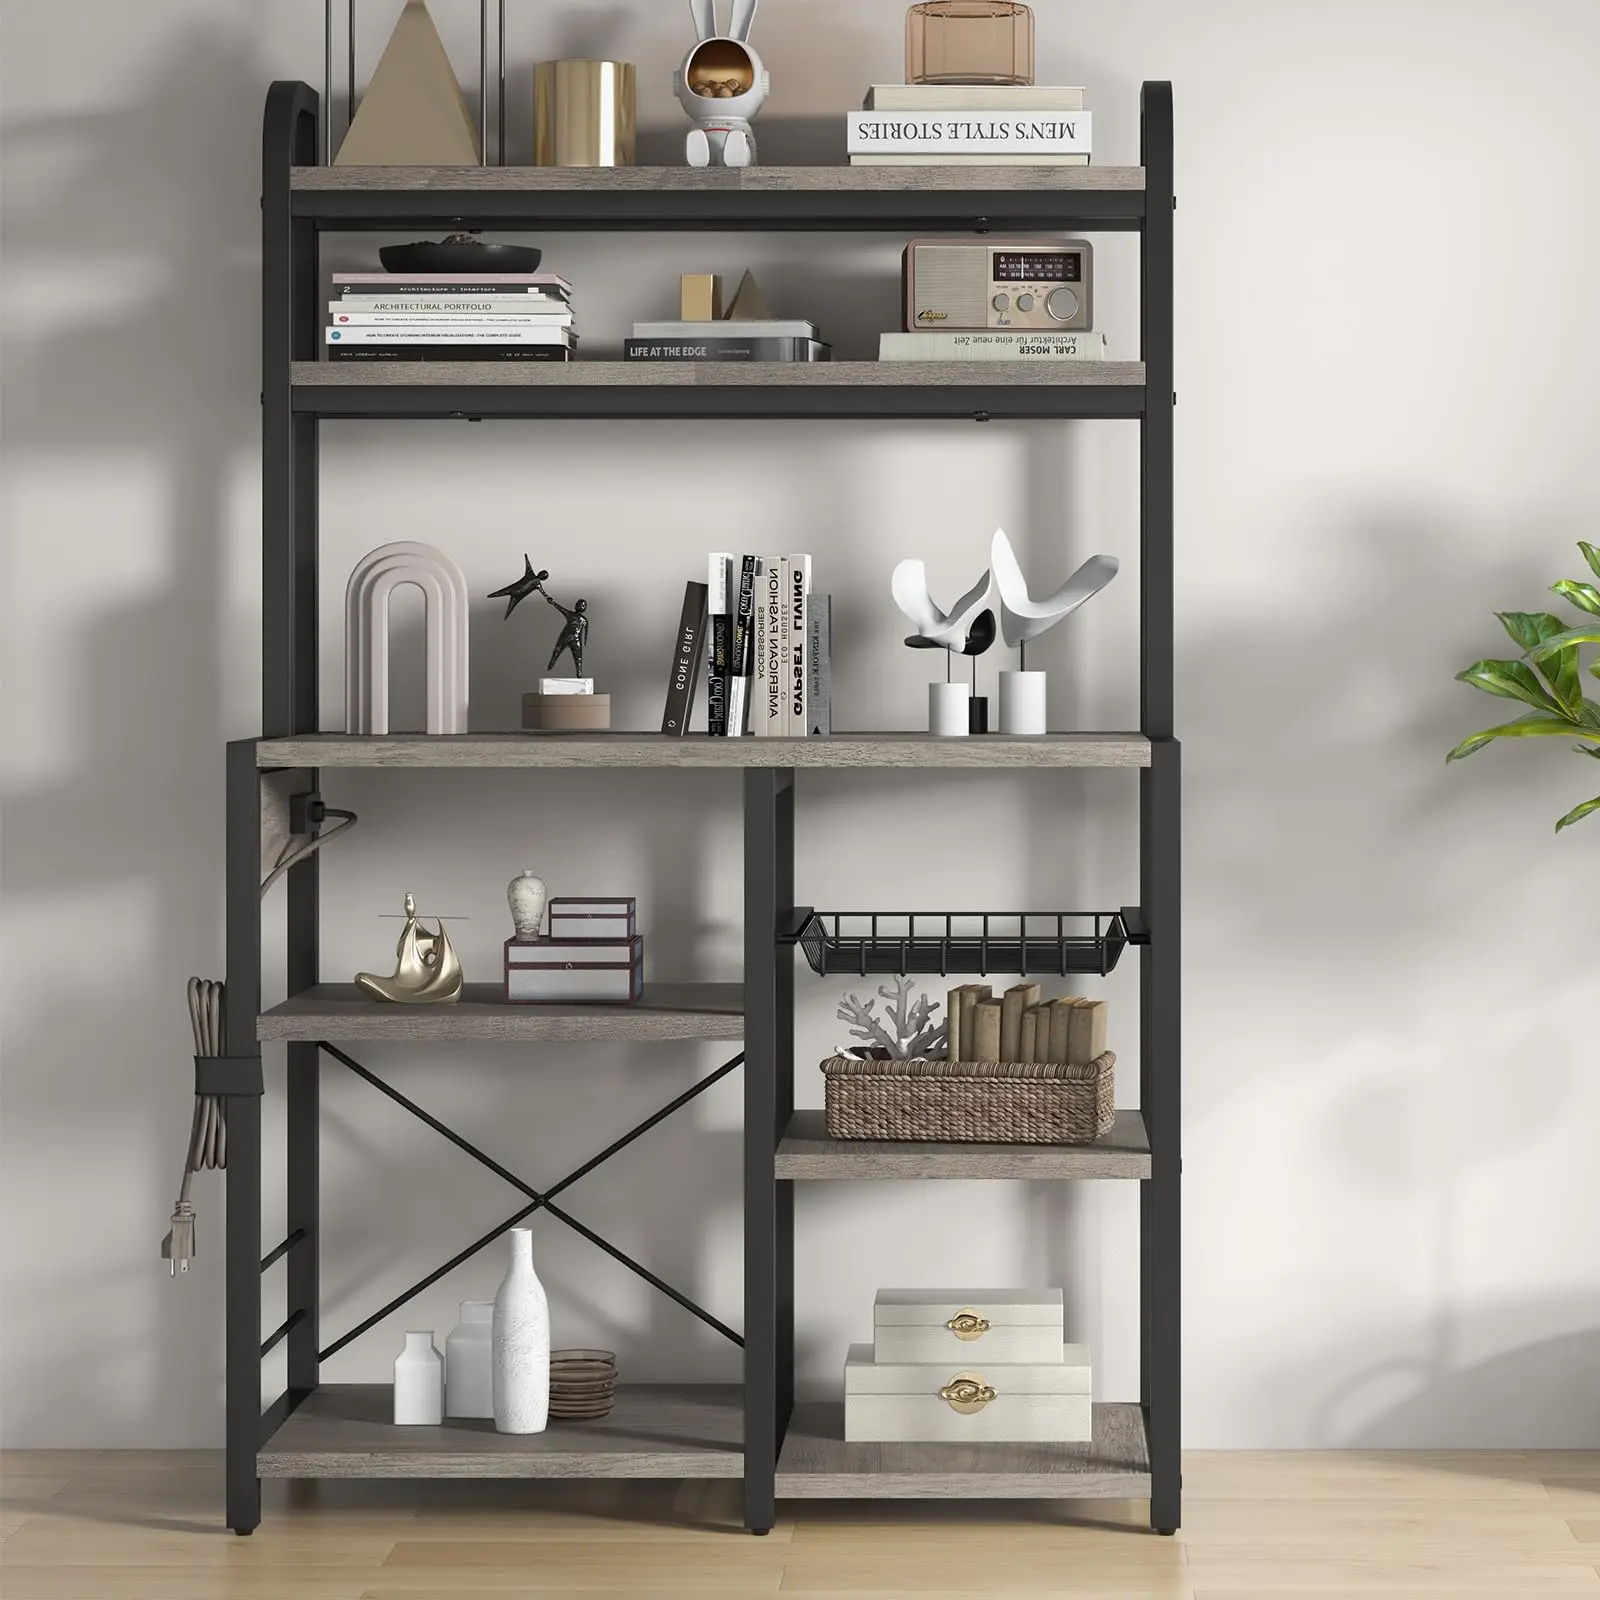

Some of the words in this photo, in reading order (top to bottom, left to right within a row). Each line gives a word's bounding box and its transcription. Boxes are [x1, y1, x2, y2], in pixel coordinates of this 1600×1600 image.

[858, 122, 943, 140] STORIES
[947, 122, 1010, 140] STYLE
[1016, 122, 1076, 140] MEN’S
[373, 303, 442, 311] ARCHITECTURAL
[444, 303, 492, 311] PORTFOLIO
[954, 336, 970, 345] Zeit
[973, 336, 993, 344] neue
[995, 336, 1013, 345] eine
[1014, 336, 1028, 345] für
[1030, 336, 1077, 345] Architektur
[629, 347, 649, 357] LIFE
[650, 347, 661, 357] AT
[663, 346, 681, 357] THE
[683, 346, 707, 356] EDGE
[1019, 345, 1050, 354] MOSER
[1054, 345, 1077, 354] CARL
